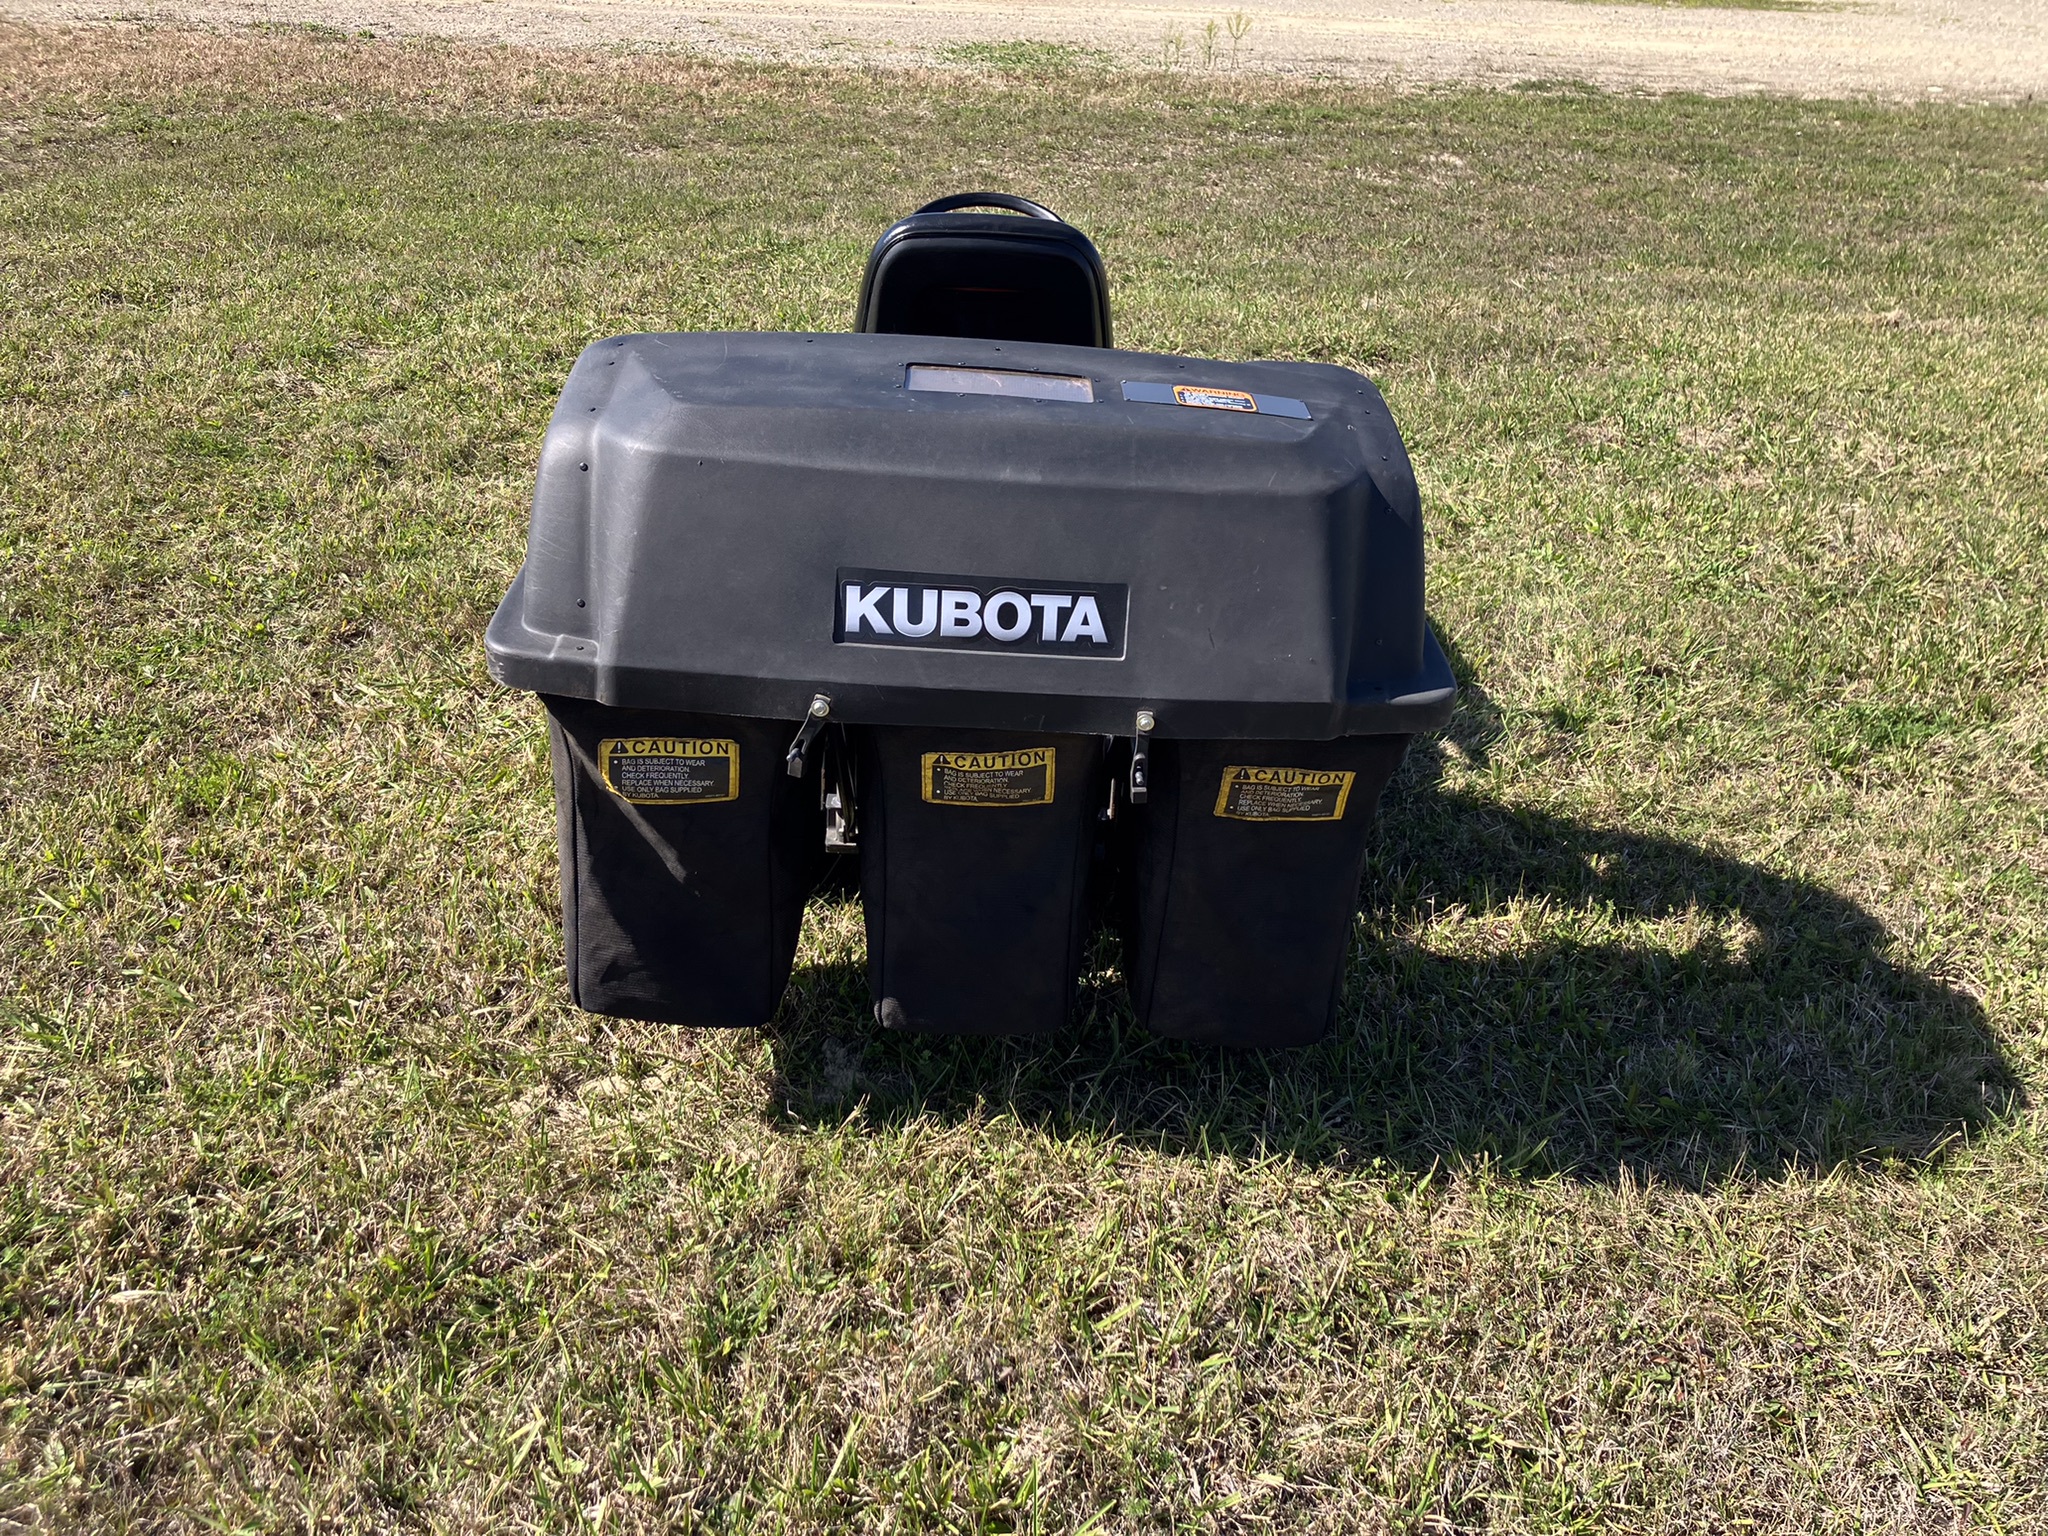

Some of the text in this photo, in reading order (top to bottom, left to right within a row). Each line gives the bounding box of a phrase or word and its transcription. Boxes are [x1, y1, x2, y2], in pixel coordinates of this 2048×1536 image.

[845, 585, 1108, 643] KUBOTA
[632, 741, 729, 755] CAUTION
[954, 751, 1045, 769] CAUTION
[944, 768, 957, 776] BAG
[1255, 770, 1345, 784] CAUTION
